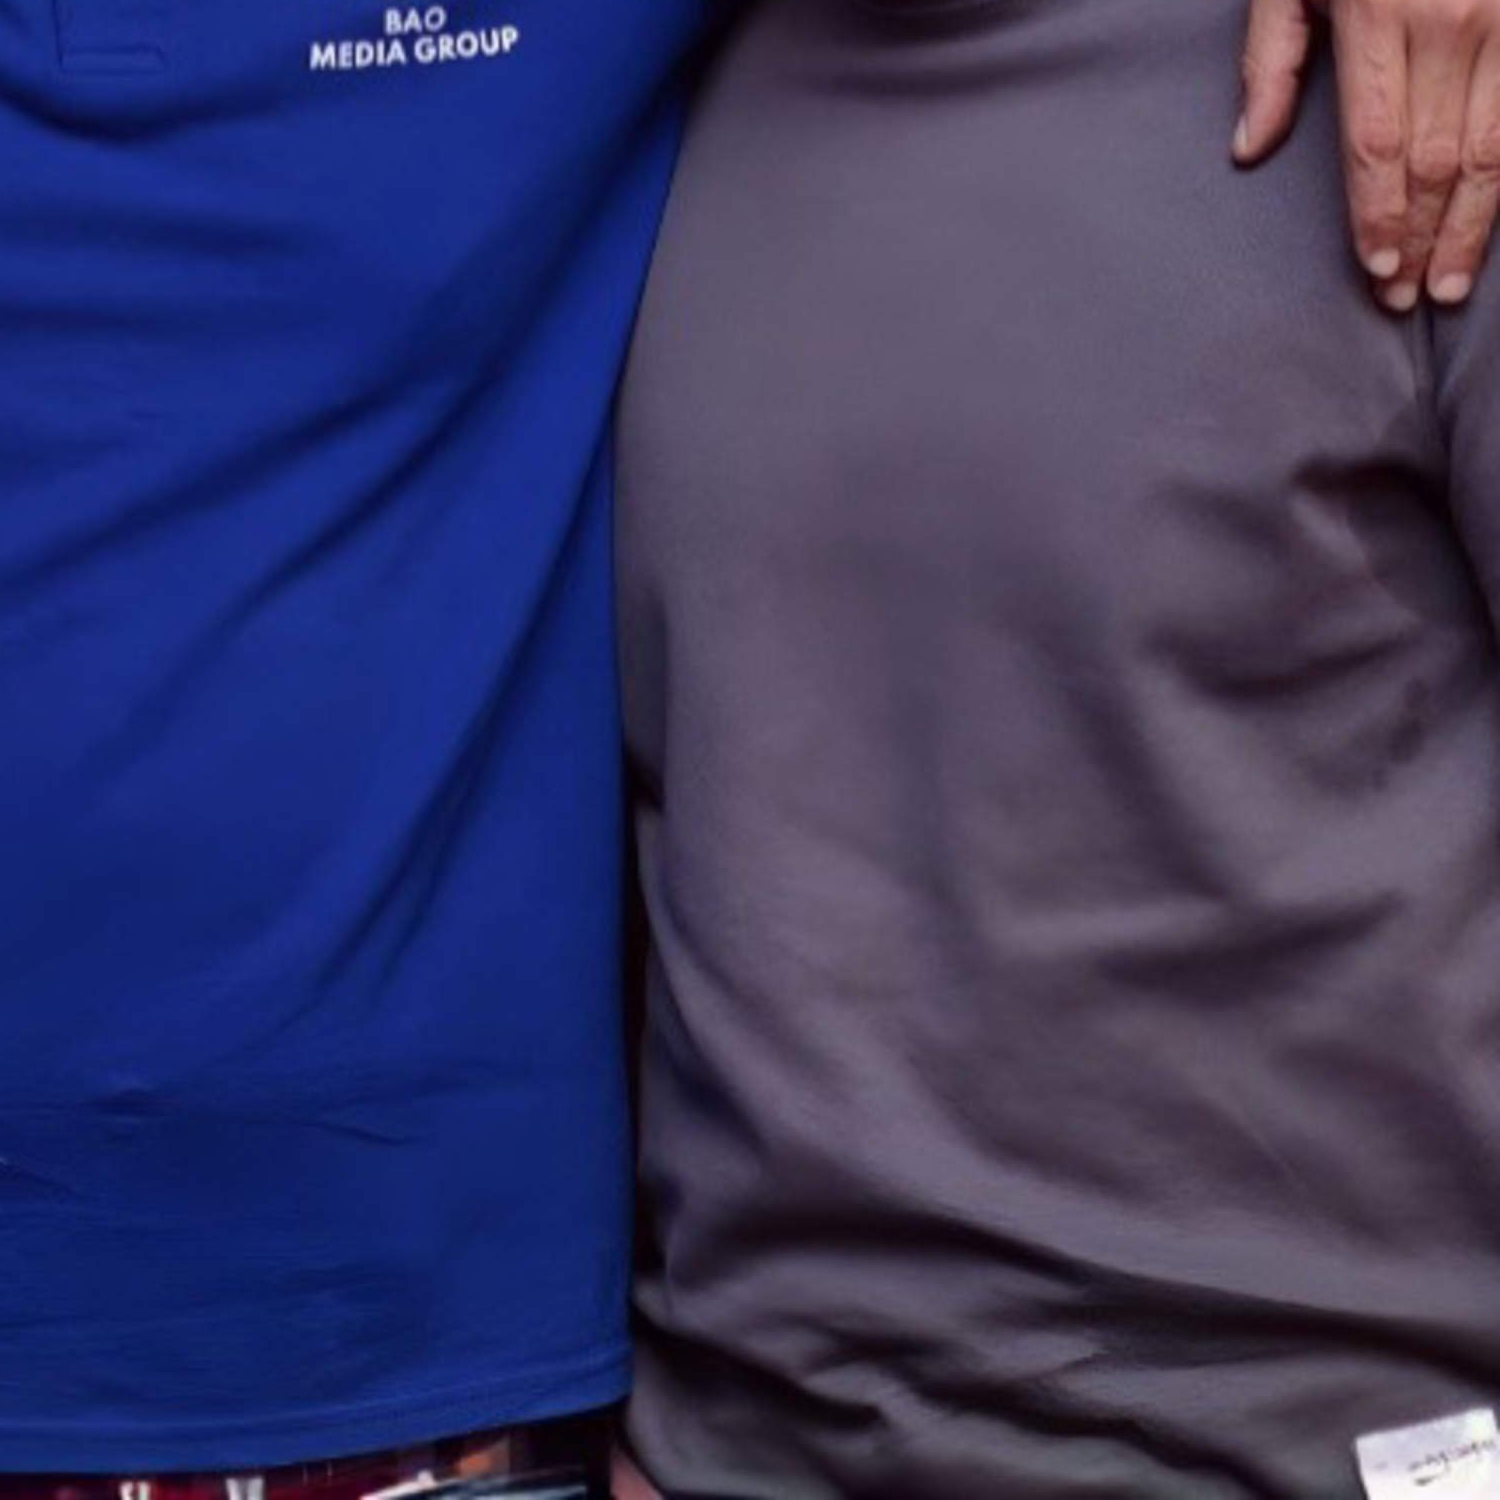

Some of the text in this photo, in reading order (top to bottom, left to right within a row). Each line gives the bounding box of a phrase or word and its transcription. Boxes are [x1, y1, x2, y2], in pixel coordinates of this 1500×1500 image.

[385, 6, 447, 34] BAO
[309, 26, 519, 69] MEDIA GROUP
